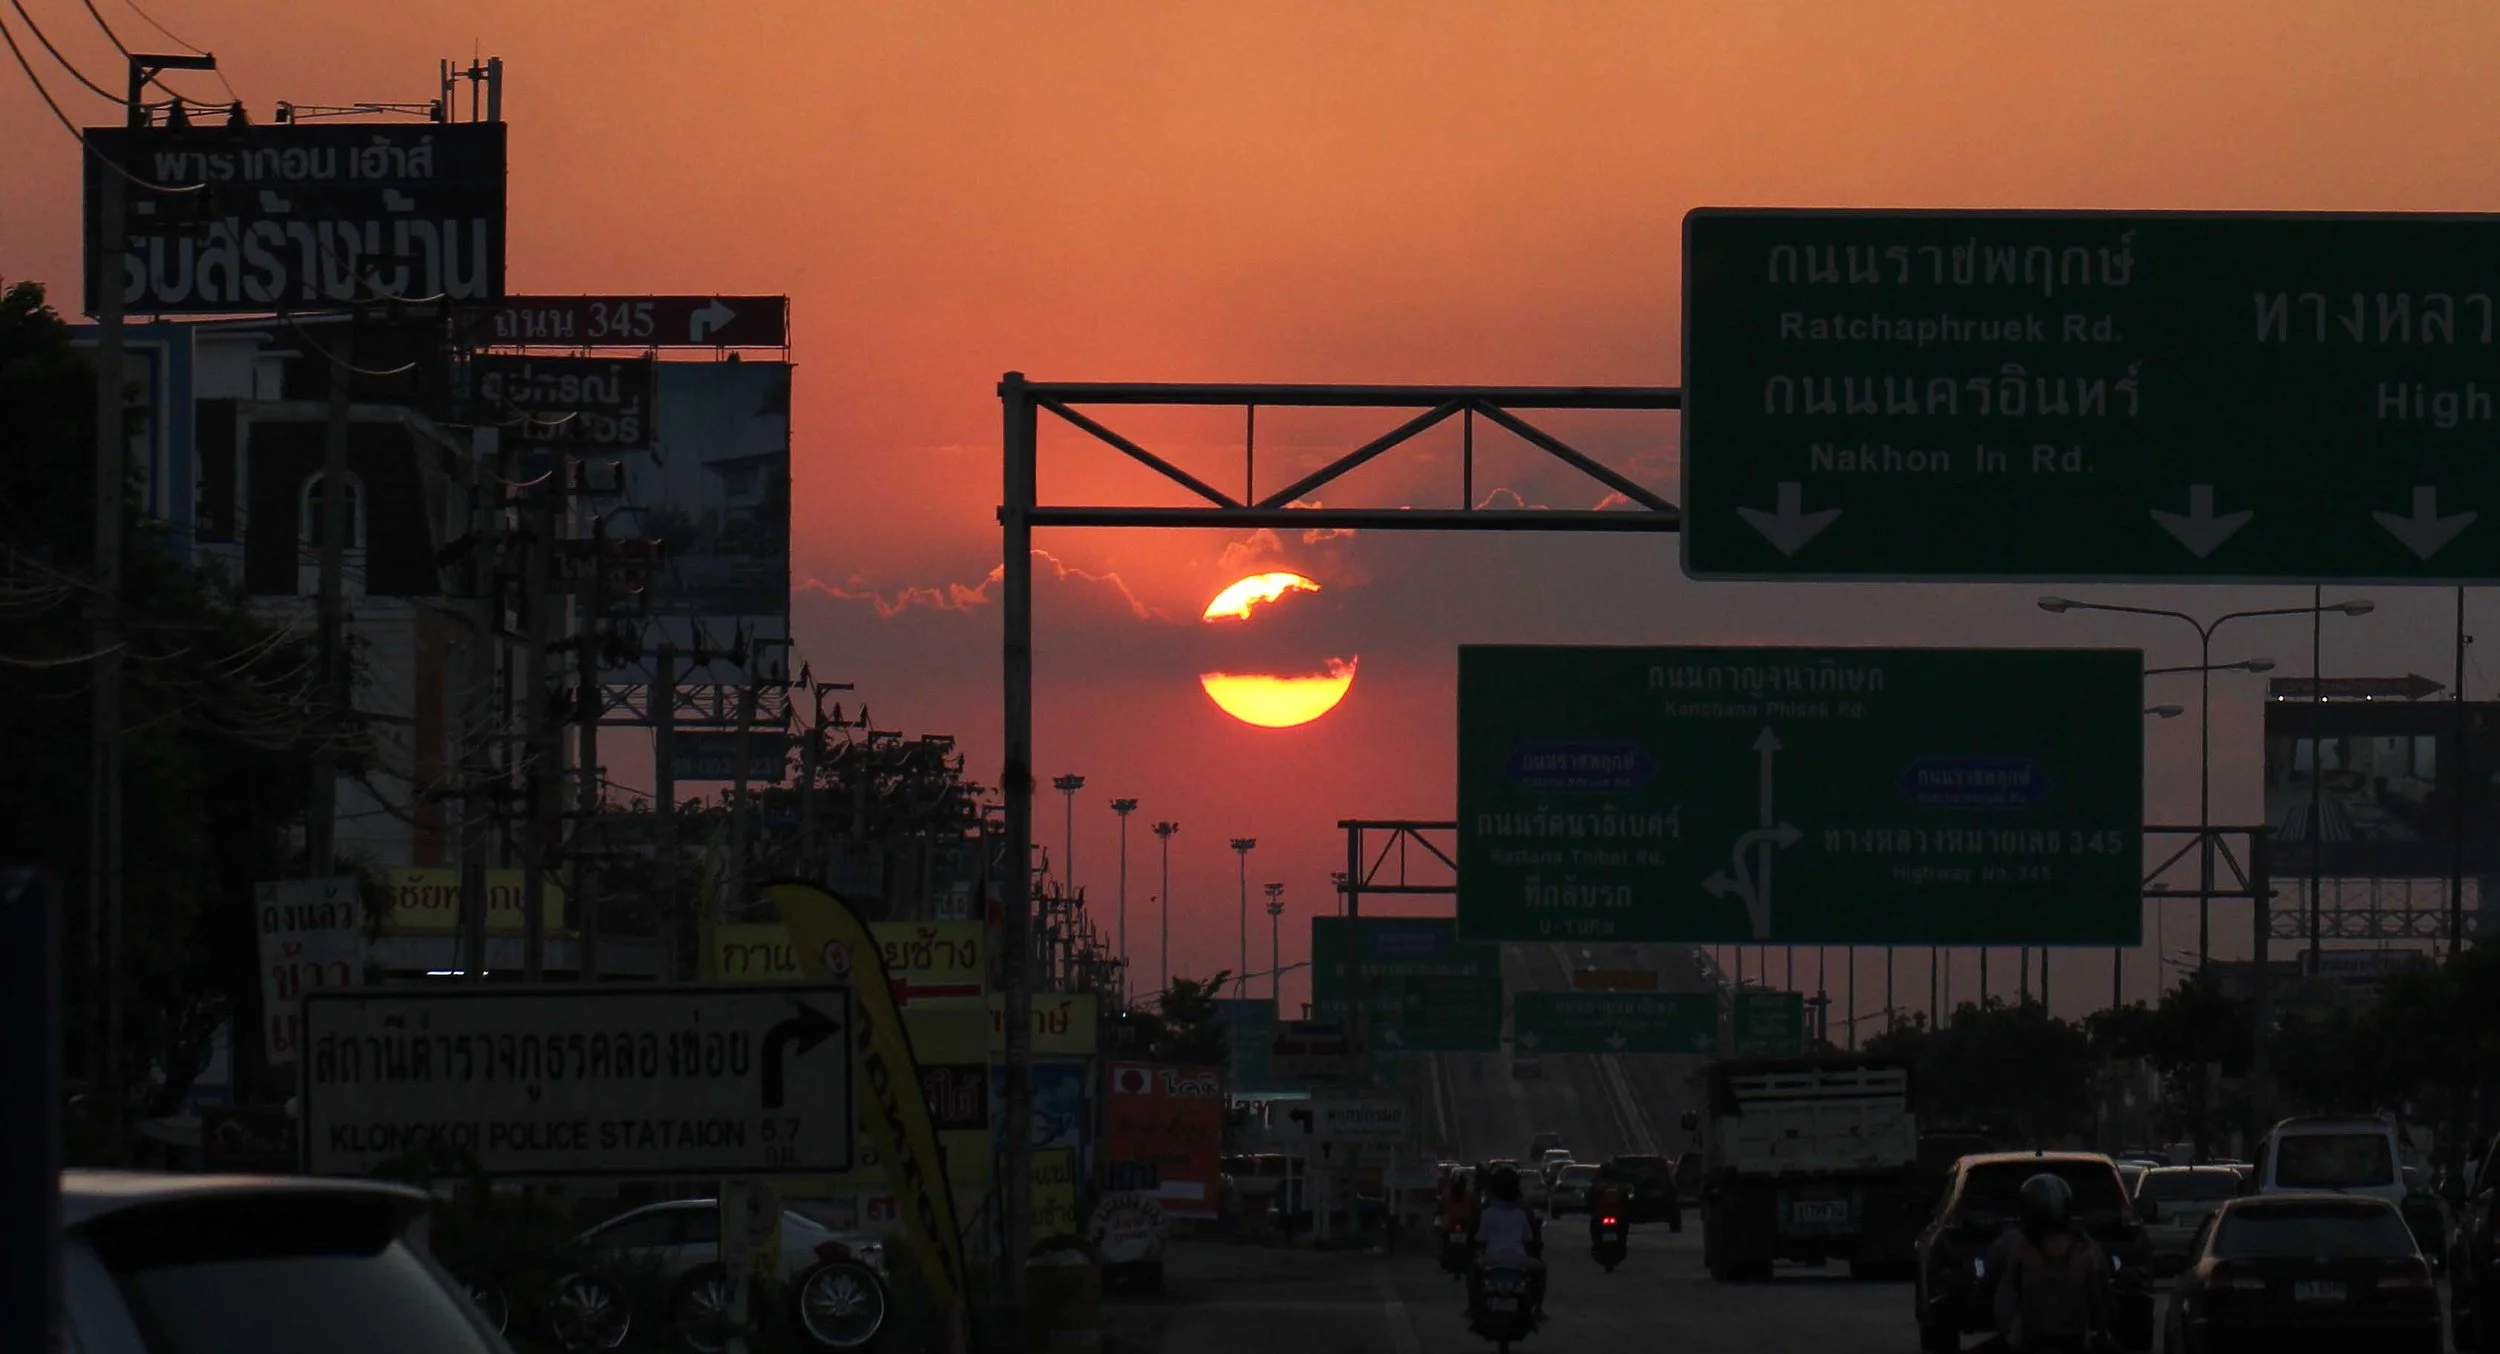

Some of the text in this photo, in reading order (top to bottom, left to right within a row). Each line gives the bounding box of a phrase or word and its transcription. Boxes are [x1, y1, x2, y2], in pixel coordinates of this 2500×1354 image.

[349, 134, 434, 179] เฮ้าส์
[1767, 229, 2137, 298] ถนนราชพฤกษ์
[493, 301, 657, 339] ถนน 345
[1780, 312, 2123, 348] Ratchaphruek Rd.
[1764, 358, 2143, 417] ถนนนครอินทร์
[1809, 443, 2095, 474] Nakhon In Rd.
[1649, 656, 1885, 699] ถนนกาญจนาภิเษก
[1822, 827, 2125, 855] ทางหลวงหมายเลข 345
[1891, 864, 1973, 885] Highway
[488, 1119, 590, 1151] POLICE
[598, 1117, 747, 1151] STATAION
